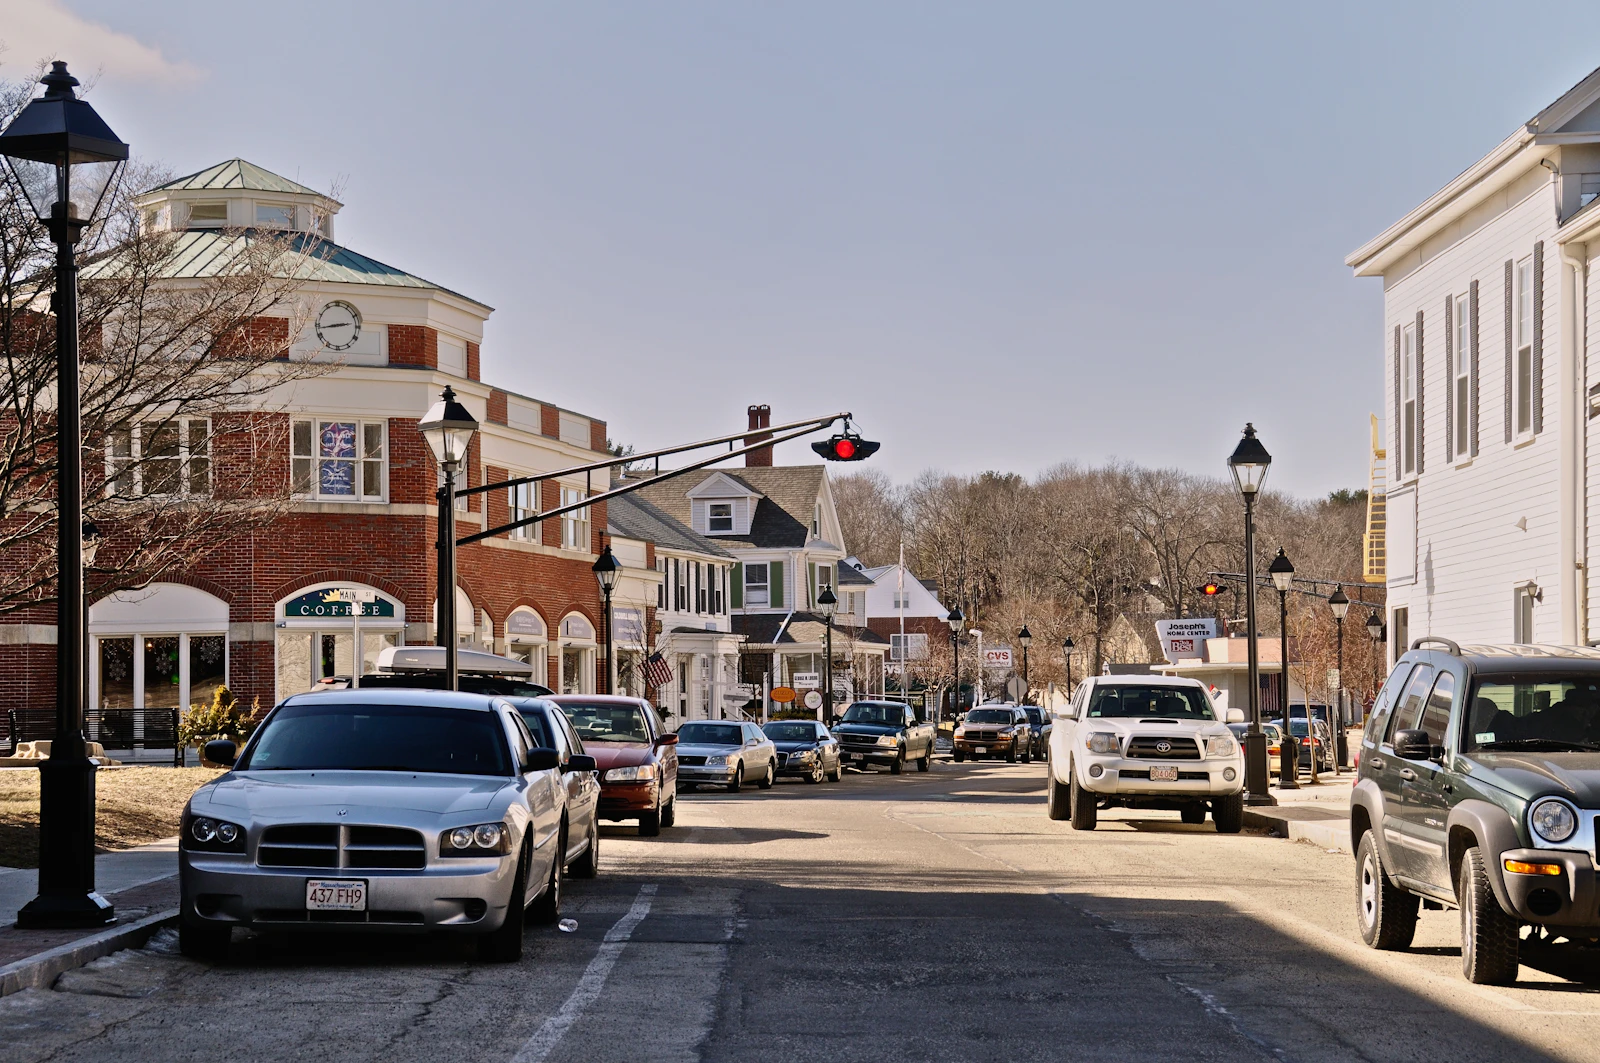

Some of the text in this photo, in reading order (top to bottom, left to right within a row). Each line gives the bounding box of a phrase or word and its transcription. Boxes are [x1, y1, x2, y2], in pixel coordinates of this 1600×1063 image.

[340, 591, 356, 600] MAIN
[300, 605, 380, 615] COFFEE
[1168, 623, 1206, 631] Joseph's
[1171, 641, 1193, 651] Best
[987, 651, 1009, 660] CVS
[309, 888, 362, 904] 437 FH9
